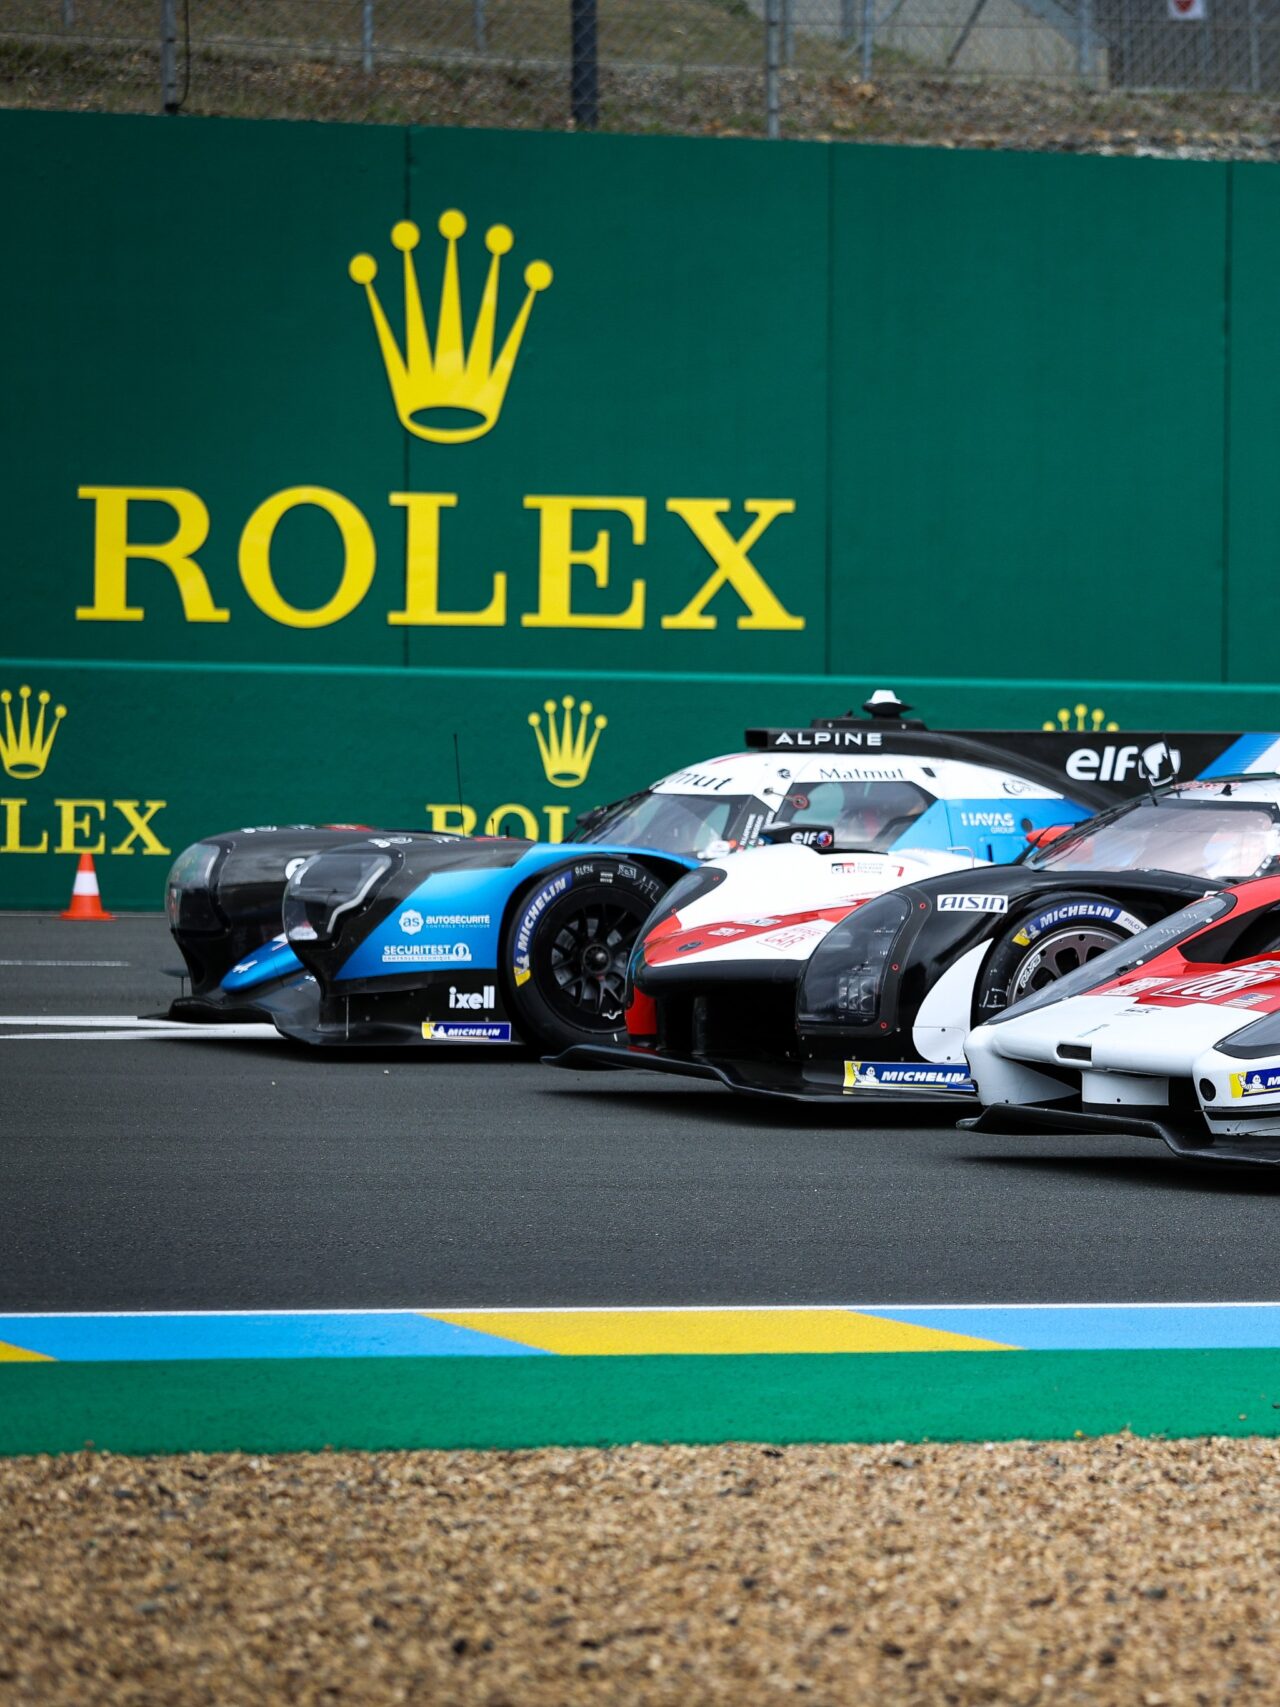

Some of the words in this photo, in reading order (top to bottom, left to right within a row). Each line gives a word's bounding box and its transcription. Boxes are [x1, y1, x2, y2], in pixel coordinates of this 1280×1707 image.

[76, 485, 805, 630] ROLEX
[774, 732, 883, 746] ALPINE
[1065, 746, 1138, 782] elf
[960, 812, 1015, 827] HAVAS
[791, 831, 818, 845] elf
[939, 896, 1007, 912] AISIN
[517, 877, 567, 953] MICHELIN
[1039, 904, 1115, 928] MICHELIN
[383, 944, 451, 955] SECURITEST
[448, 985, 495, 1010] ixell
[448, 1028, 501, 1037] MICHELIN
[881, 1070, 965, 1083] MICHELIN
